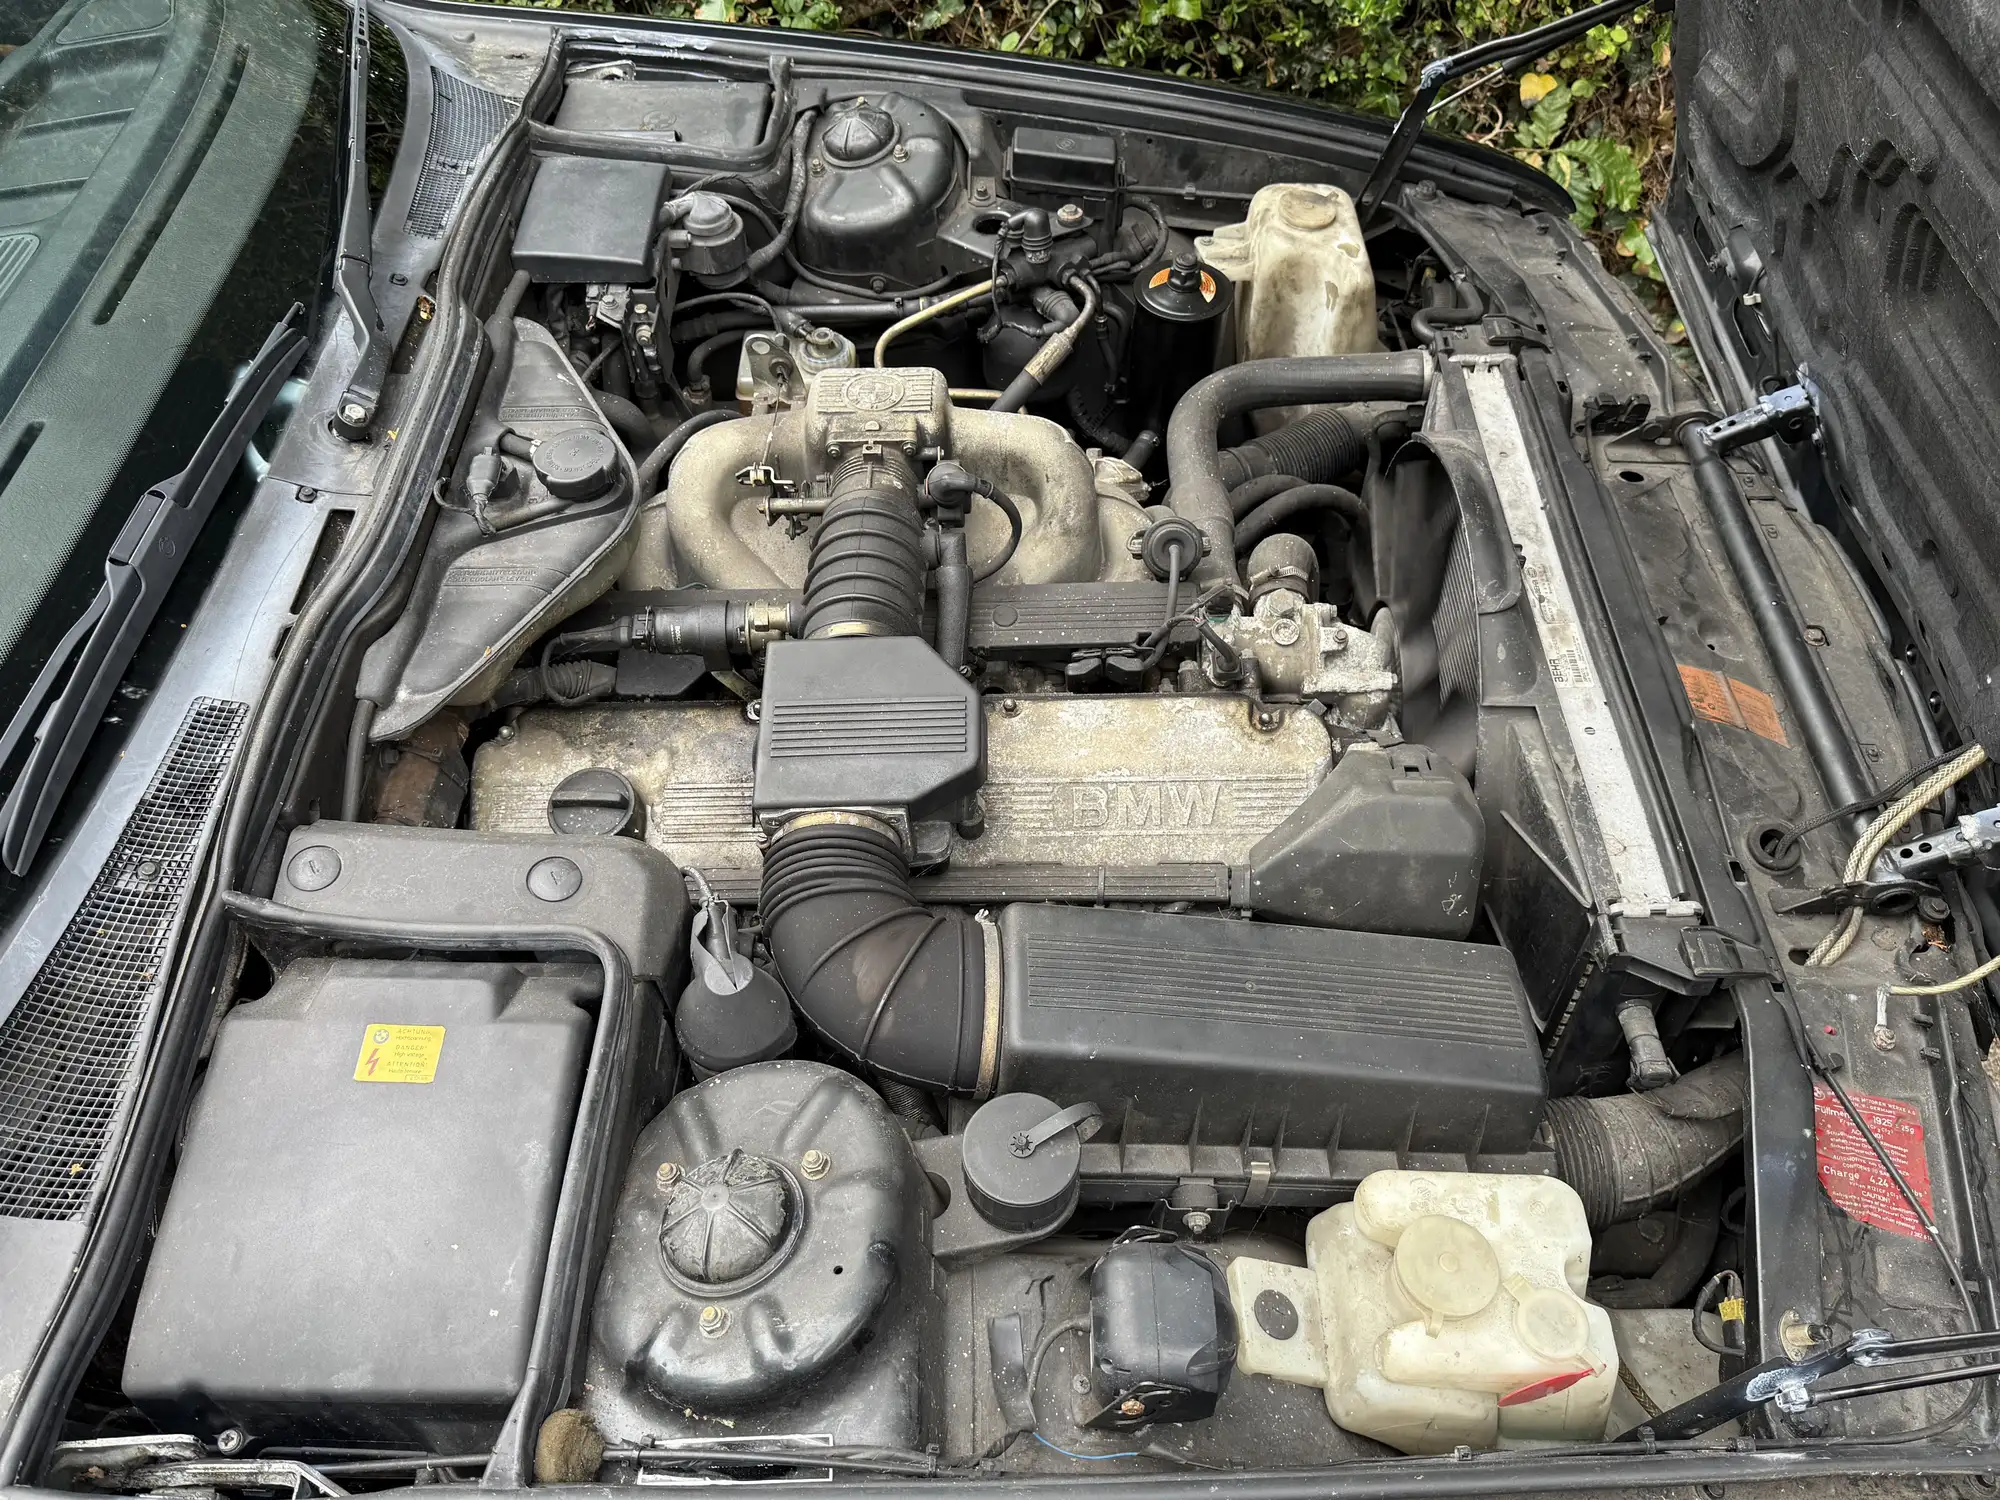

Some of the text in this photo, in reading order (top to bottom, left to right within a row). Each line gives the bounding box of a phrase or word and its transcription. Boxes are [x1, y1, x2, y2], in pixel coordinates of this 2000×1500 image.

[1549, 658, 1564, 683] BEHR
[1073, 782, 1221, 827] BMW
[1872, 1116, 1893, 1127] 1925
[1823, 1165, 1860, 1180] Charge
[1869, 1175, 1889, 1188] 4.24
